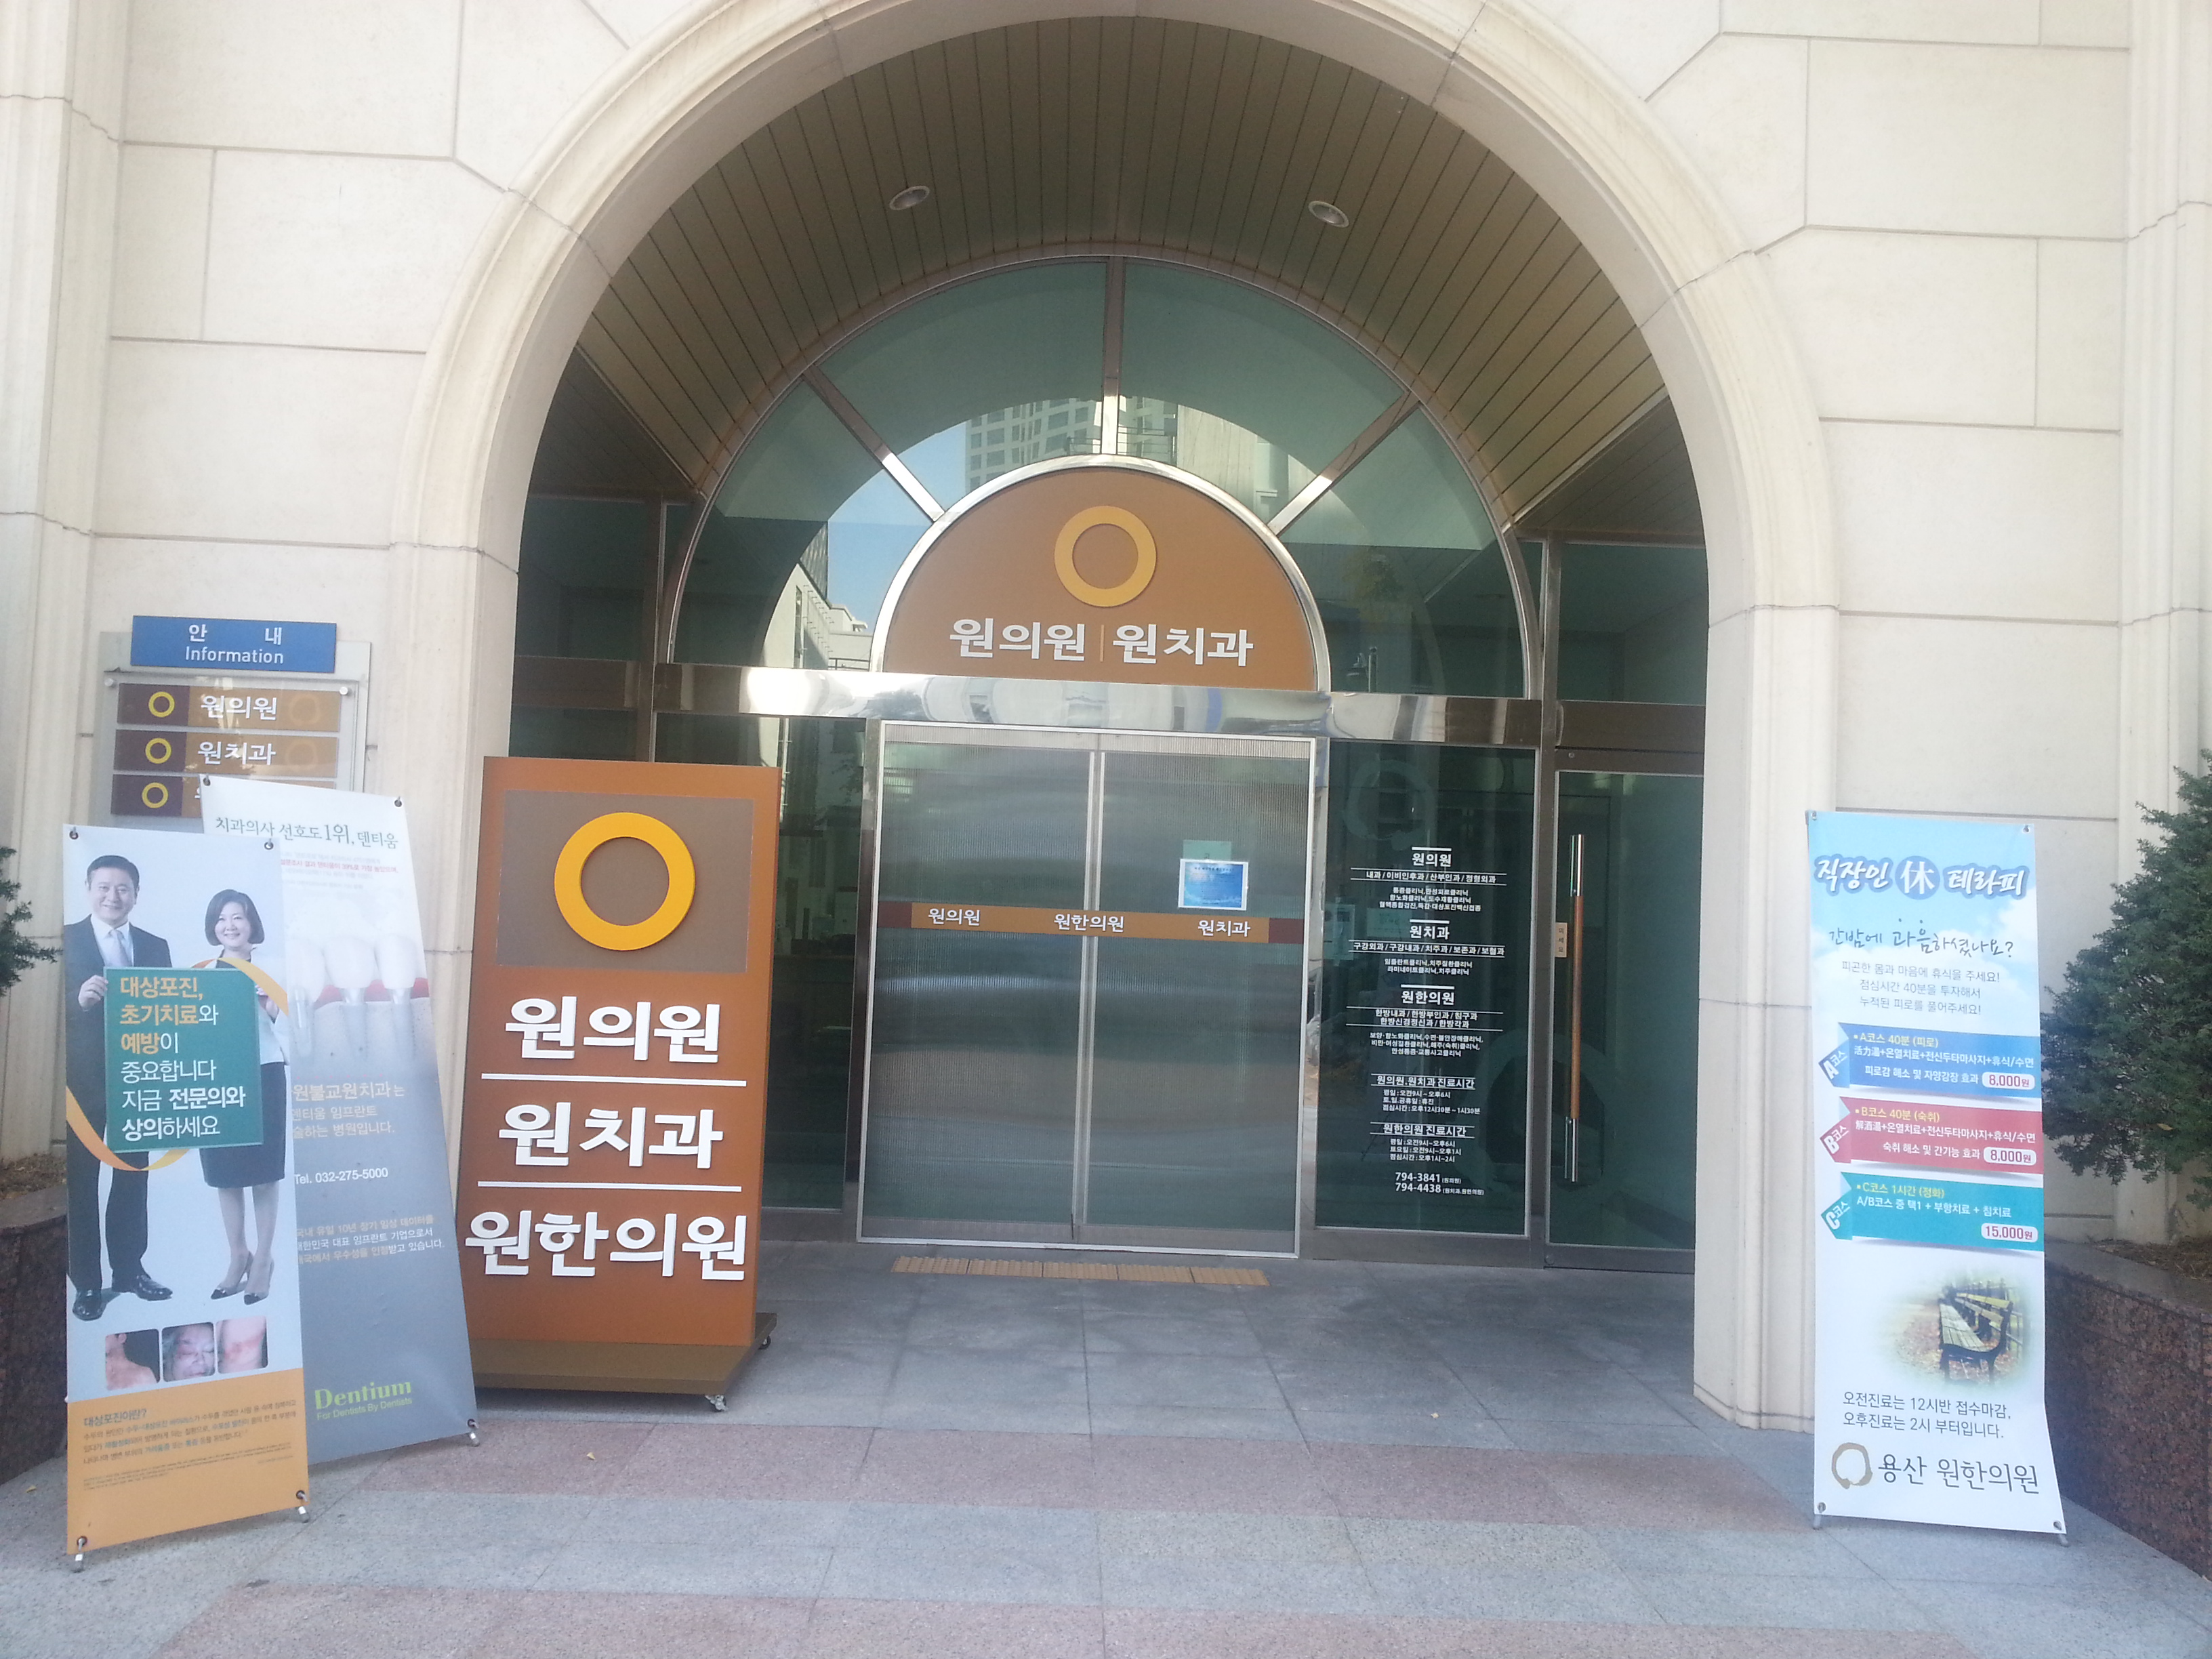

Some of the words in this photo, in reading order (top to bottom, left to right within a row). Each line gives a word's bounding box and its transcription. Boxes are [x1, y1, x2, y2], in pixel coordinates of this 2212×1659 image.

[949, 617, 1085, 661] 원의원
[1113, 623, 1254, 667] 원치과
[185, 647, 283, 663] Information
[201, 696, 277, 720] 원의원
[198, 741, 276, 765] 원치과
[216, 817, 275, 836] 치과의사
[358, 832, 398, 849] 덴티움
[1412, 853, 1452, 867] 원의원
[1818, 859, 1889, 892] 직장인
[1900, 861, 1935, 895] 休
[1948, 867, 2026, 895] 테라피
[928, 907, 981, 926] 원의원
[1054, 912, 1125, 933] 원한의원
[1197, 919, 1251, 938] 원치과
[1410, 925, 1450, 940] 원치과
[1829, 926, 1882, 948] 간밤에
[1893, 928, 2013, 958] 과음하셨나요?
[1843, 961, 1870, 974] 피곤한
[1898, 965, 1928, 978] 마음에
[1931, 968, 1961, 981] 휴식을
[1966, 970, 2000, 983] 주세요!
[120, 977, 203, 1000] 대상포진,
[1401, 990, 1454, 1006] 원한의원
[1860, 979, 1900, 993] 점심시간
[1904, 983, 1937, 996] 40분을
[1940, 985, 1981, 998] 투자해서
[120, 1004, 219, 1026] 초기치료와
[1860, 998, 1889, 1010] 누적된
[1893, 1000, 1923, 1012] 피로를
[1927, 1002, 1981, 1015] 풀어주세요!
[506, 996, 720, 1063] 원의원
[1860, 1033, 1885, 1043] A코스
[1888, 1035, 1910, 1046] 40분
[1912, 1036, 1939, 1048] (피로)
[121, 1032, 179, 1054] 예방이
[121, 1060, 216, 1083] 중요합니다
[1437, 1077, 1475, 1088] 진료시간
[1865, 1065, 1891, 1077] 피로감
[1893, 1068, 1910, 1078] 해소
[1913, 1069, 1921, 1080] 및
[1924, 1070, 1959, 1083] 자양강장
[1961, 1073, 1979, 1084] 효과
[1989, 1074, 2030, 1088] 8,000원
[123, 1089, 162, 1111] 지금
[169, 1086, 245, 1109] 전문의와
[331, 1105, 378, 1118] 임프란트
[1862, 1107, 1887, 1118] B코스
[1889, 1109, 1910, 1120] 40분
[1914, 1110, 1940, 1123] (숙취)
[123, 1115, 220, 1141] 상의하세요
[333, 1122, 394, 1136] 병원입니다.
[499, 1102, 724, 1169] 원치과
[1383, 1124, 1422, 1135] 원한의원
[1426, 1126, 1467, 1136] 진료시간
[1883, 1142, 1900, 1153] 숙취
[1903, 1143, 1920, 1154] 해소
[1923, 1145, 1931, 1155] 및
[1934, 1145, 1959, 1158] 간기능
[1963, 1148, 1980, 1159] 효과
[1990, 1150, 2031, 1163] 8,000원
[294, 1174, 312, 1185] Tel.
[315, 1168, 388, 1183] 032-275-5000
[1395, 1172, 1440, 1183] 794-3841
[1395, 1183, 1441, 1193] 794-4438
[1863, 1183, 1888, 1193] C코스
[1893, 1185, 1917, 1197] 1시간
[1919, 1187, 1945, 1198] (정화)
[1857, 1197, 1893, 1208] A/B코스
[1896, 1200, 1905, 1210] 중
[1908, 1201, 1921, 1210] 택1
[1934, 1203, 1970, 1214] 부항치료
[1983, 1206, 2011, 1218] 침치료
[316, 1225, 334, 1235] 유일
[339, 1223, 356, 1233] 10년
[333, 1237, 350, 1247] 대표
[353, 1233, 388, 1246] 임프란트
[391, 1227, 433, 1240] 기업으로서
[1986, 1225, 2032, 1240] 15,000원
[409, 1240, 445, 1252] 있습니다.
[465, 1210, 747, 1281] 원한의원
[314, 1381, 411, 1410] Dentium
[1843, 1392, 1905, 1410] 오전진료는
[1910, 1397, 1951, 1414] 12시반
[1956, 1401, 2011, 1420] 접수마감,
[317, 1412, 331, 1420] For
[333, 1406, 366, 1418] Dentists
[368, 1404, 378, 1412] By
[380, 1397, 412, 1409] Dentists
[1843, 1412, 1905, 1431] 오후진료는
[1910, 1418, 1930, 1433] 2시
[1935, 1420, 2004, 1439] 부터입니다.
[1878, 1454, 1927, 1485] 용산
[1937, 1458, 2039, 1495] 원한의원
